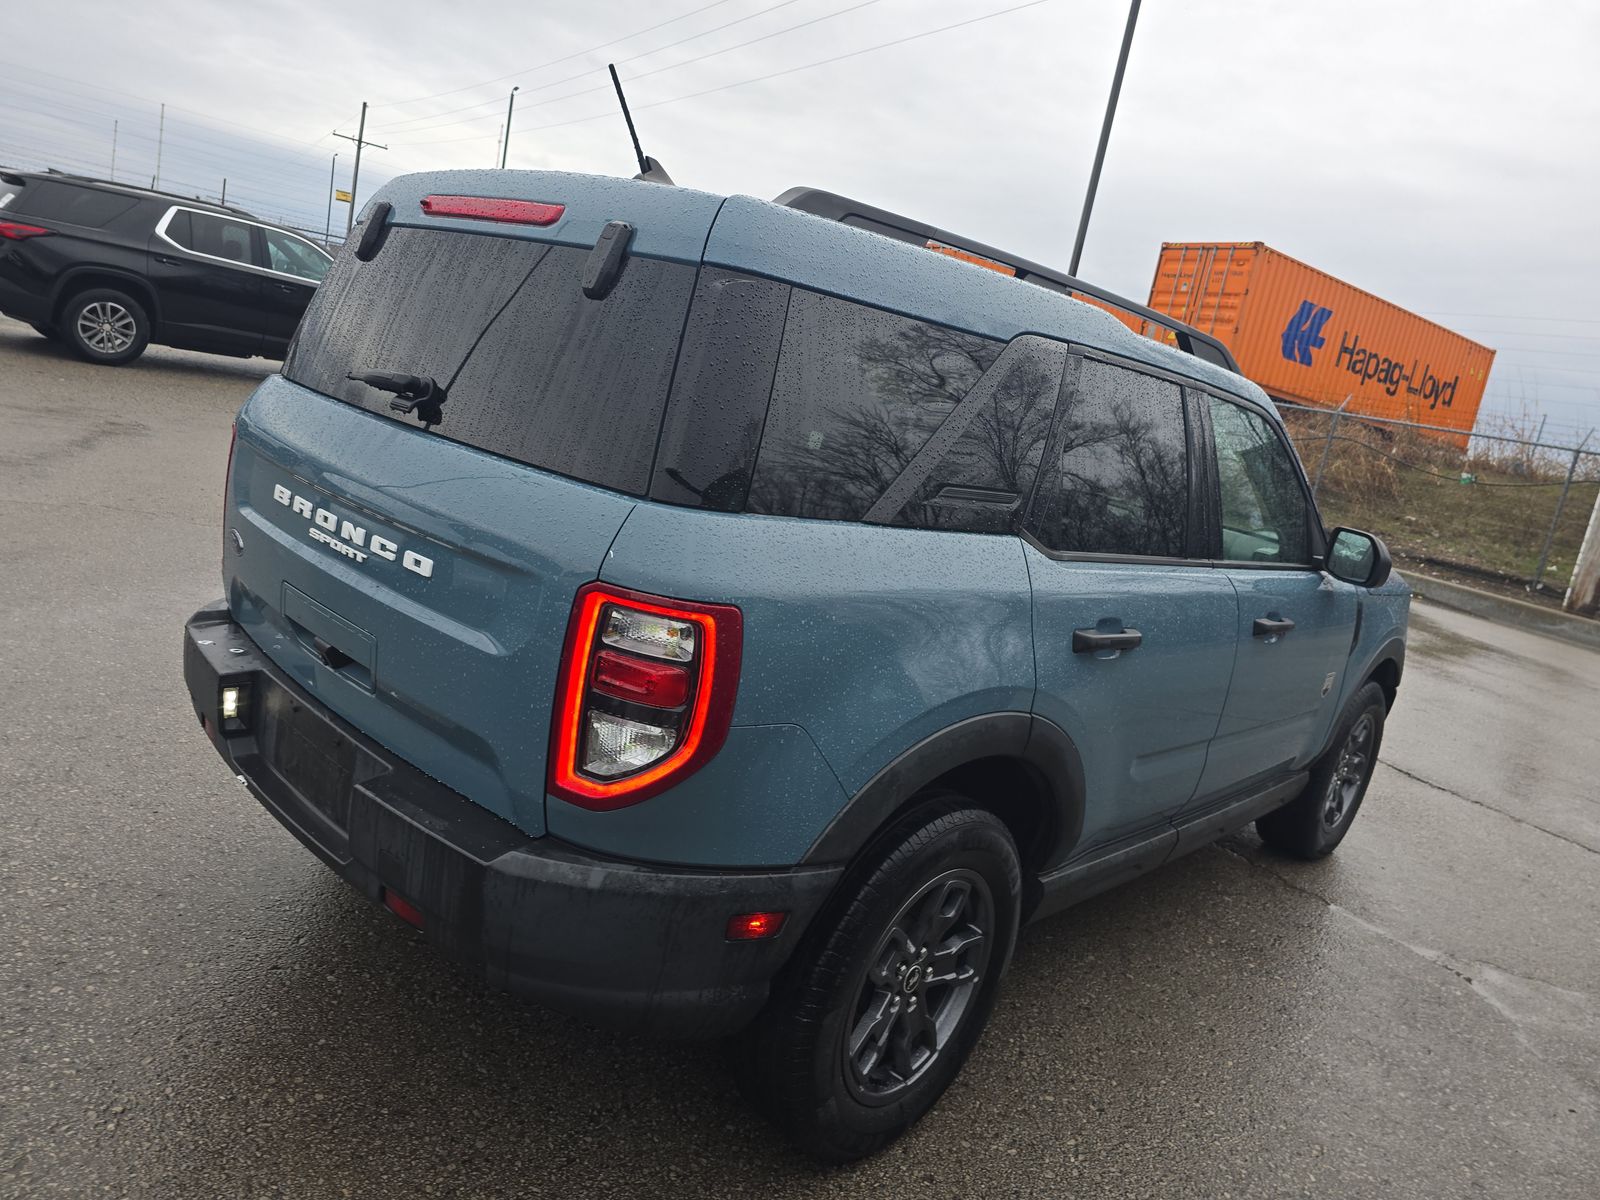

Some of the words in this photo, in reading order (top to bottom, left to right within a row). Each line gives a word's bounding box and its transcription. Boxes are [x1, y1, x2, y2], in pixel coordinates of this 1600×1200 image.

[1335, 331, 1459, 410] Hapag-Lloyd
[273, 483, 433, 578] BRONCO
[308, 527, 368, 563] SPORT
